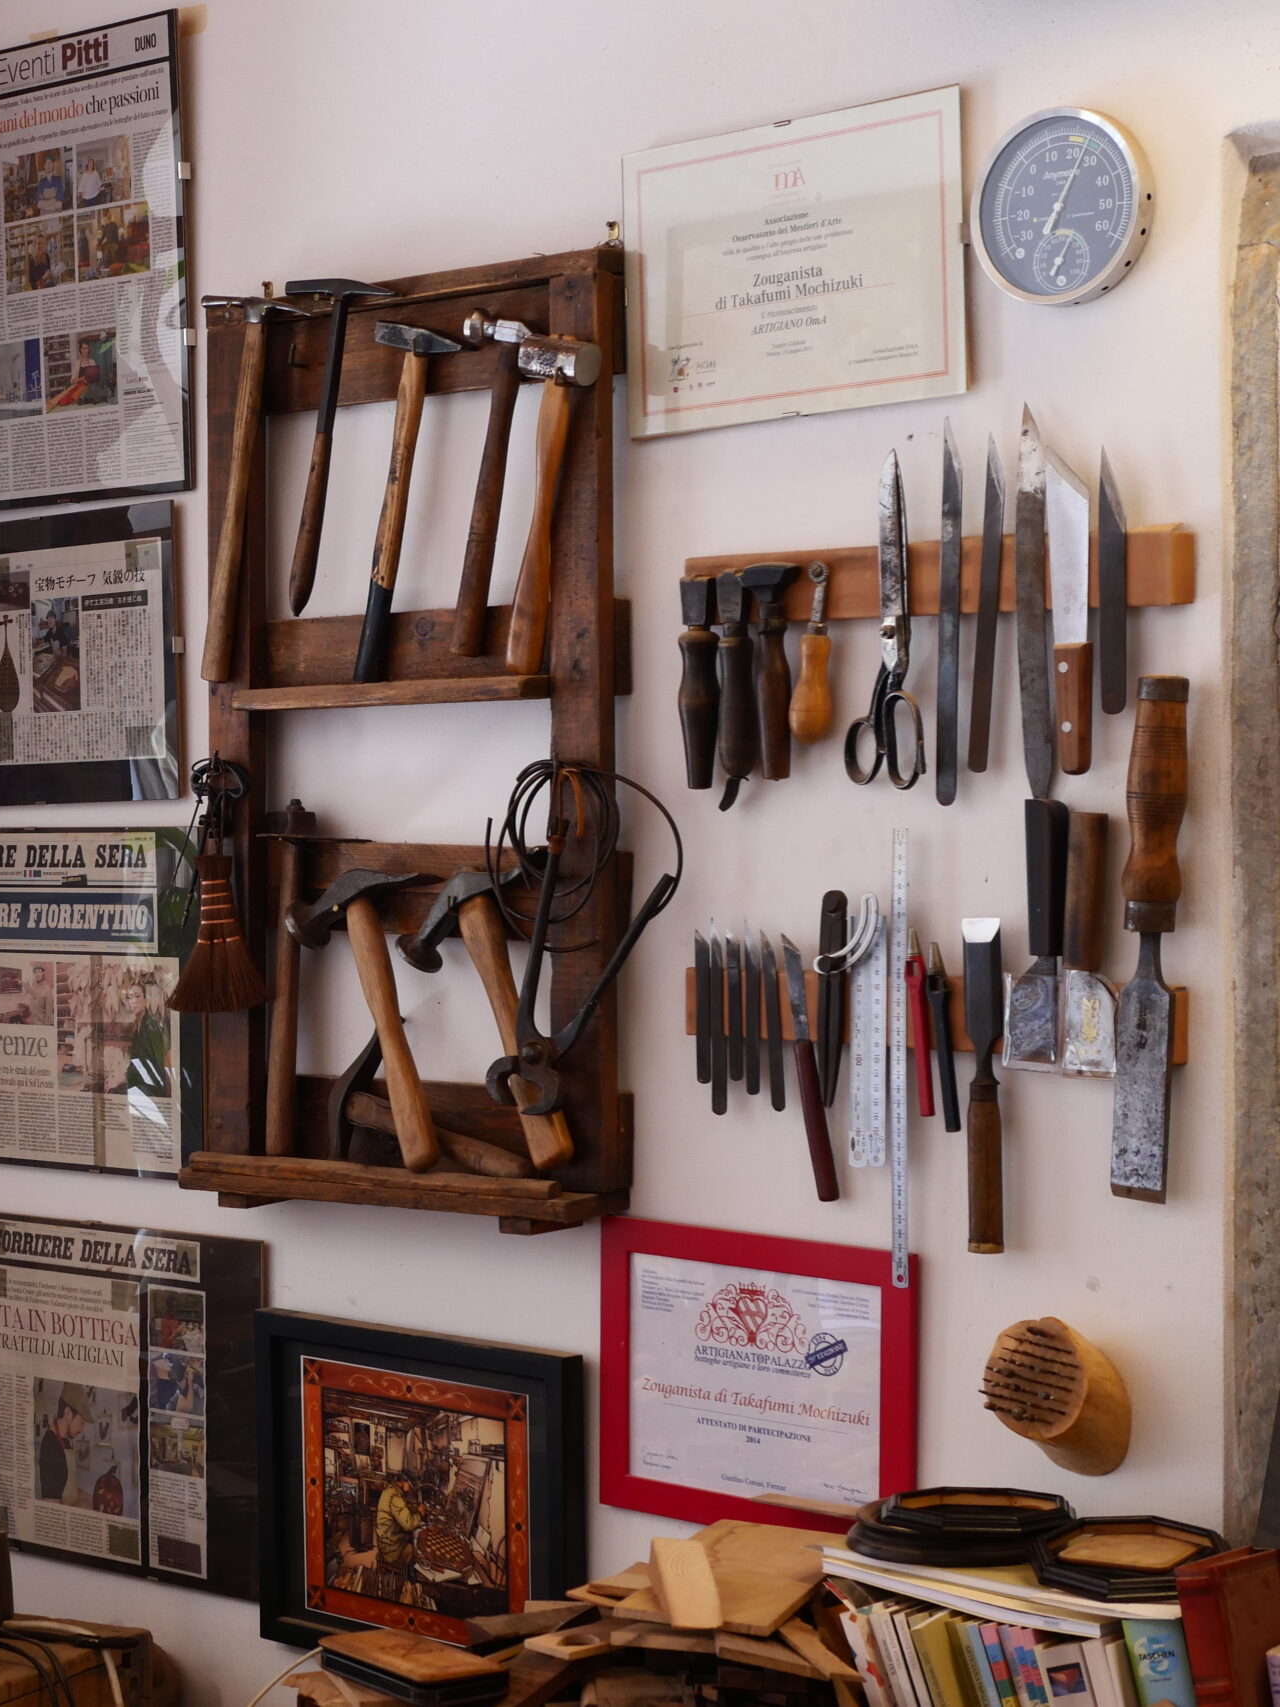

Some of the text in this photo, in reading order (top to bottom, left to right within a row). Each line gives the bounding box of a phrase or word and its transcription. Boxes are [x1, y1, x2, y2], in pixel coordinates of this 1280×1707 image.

[134, 33, 157, 52] DUNO
[61, 33, 109, 71] Pitti
[20, 107, 37, 129] del
[39, 99, 84, 127] mondo
[85, 95, 107, 115] che
[108, 81, 160, 115] passioni
[1045, 151, 1058, 163] 10
[1066, 148, 1080, 160] 20
[1083, 155, 1097, 167] 30
[1030, 164, 1037, 175] 0
[1095, 176, 1109, 187] 40
[1015, 186, 1034, 197] -10
[1099, 199, 1113, 209] 50
[764, 210, 810, 226] Associazione
[1011, 210, 1030, 221] -20
[732, 217, 843, 243] Osservatorio dei Mestieri d'Arte
[1095, 221, 1109, 231] 60
[1014, 230, 1033, 241] -30
[753, 265, 823, 287] Zouganista
[715, 274, 863, 310] di Takafumi Mochizuki
[766, 304, 818, 318] riconoscimento
[751, 318, 803, 336] ARTIGIANO
[35, 567, 145, 593] 宝物モチーフ 気鋭の技
[24, 845, 86, 868] DELLA
[95, 844, 147, 868] SERA
[27, 902, 148, 930] FIORENTINO
[855, 1053, 863, 1066] 100
[79, 1239, 137, 1268] DELLA
[141, 1246, 191, 1275] SERA
[27, 1308, 47, 1333] IN
[51, 1311, 138, 1347] BOTTEGA
[41, 1339, 55, 1357] DI
[57, 1342, 124, 1367] ARTIGIANI
[722, 1358, 751, 1370] artigiane
[757, 1363, 771, 1372] loro
[641, 1377, 870, 1427] Zouganista di Takafumi Mochizuki
[696, 1417, 812, 1443] ATTESTATO DI PARTECIPAZIONE
[745, 1436, 761, 1445] 2014
[766, 1481, 786, 1491] Firenze
[1138, 1650, 1175, 1662] TASCHEN
